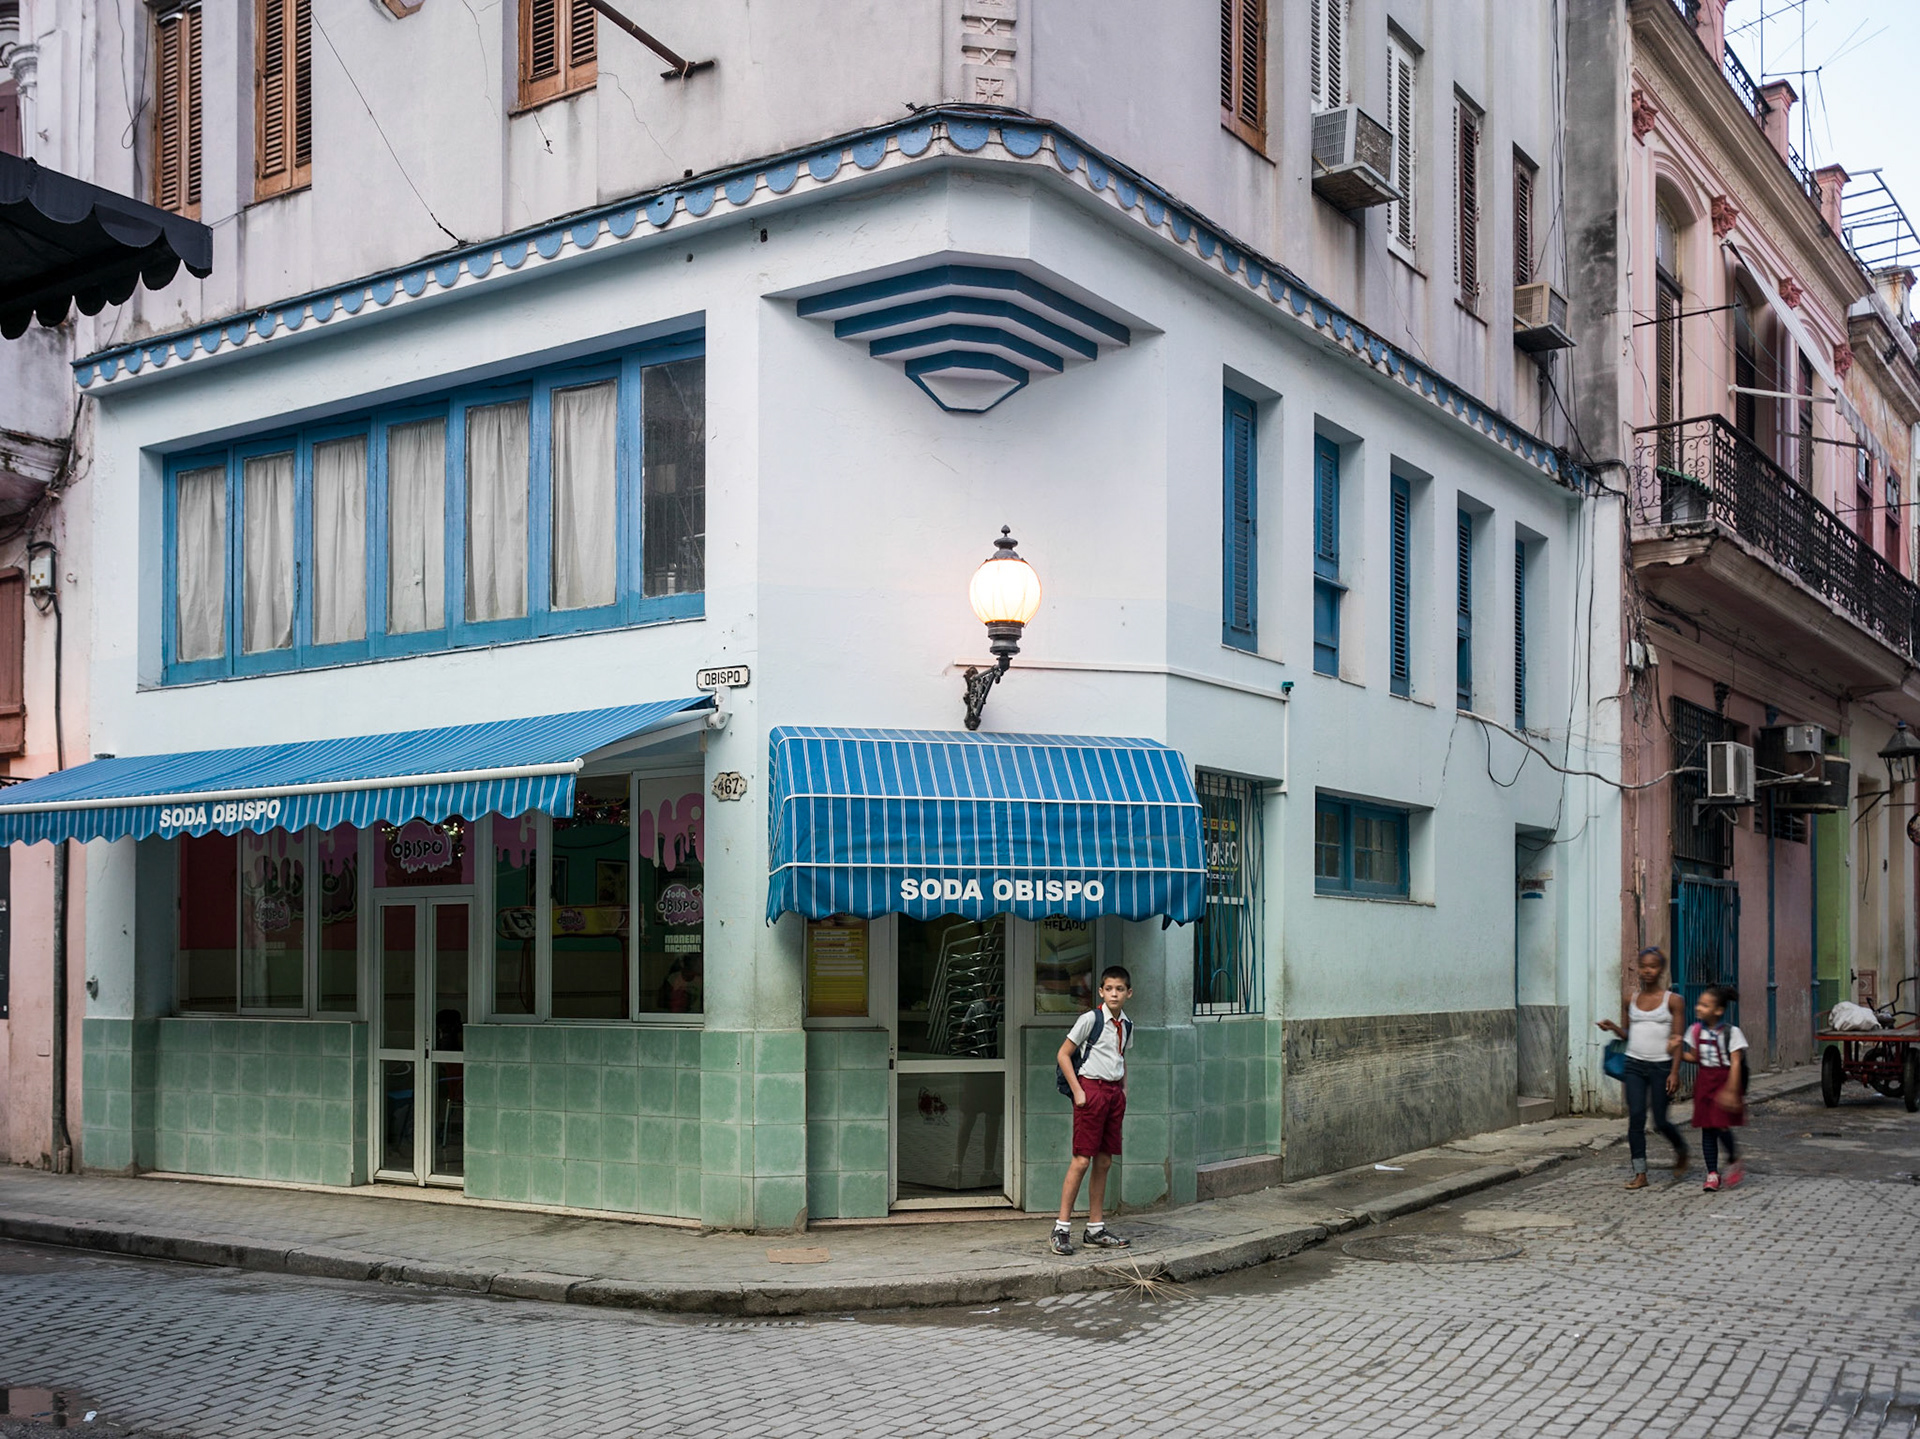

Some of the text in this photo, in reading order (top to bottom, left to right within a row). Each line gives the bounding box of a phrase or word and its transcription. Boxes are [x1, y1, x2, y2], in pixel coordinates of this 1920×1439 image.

[704, 670, 741, 686] OBISPO
[717, 777, 740, 796] 467
[159, 799, 281, 828] SODA OBISPO
[391, 839, 443, 860] OBISPO
[666, 888, 686, 899] Soda
[900, 878, 1105, 902] SODA OBISPO
[657, 899, 700, 913] OBISPO
[1044, 919, 1087, 931] HELADO
[664, 934, 702, 944] MONEDA
[664, 944, 702, 953] NACIONAL
